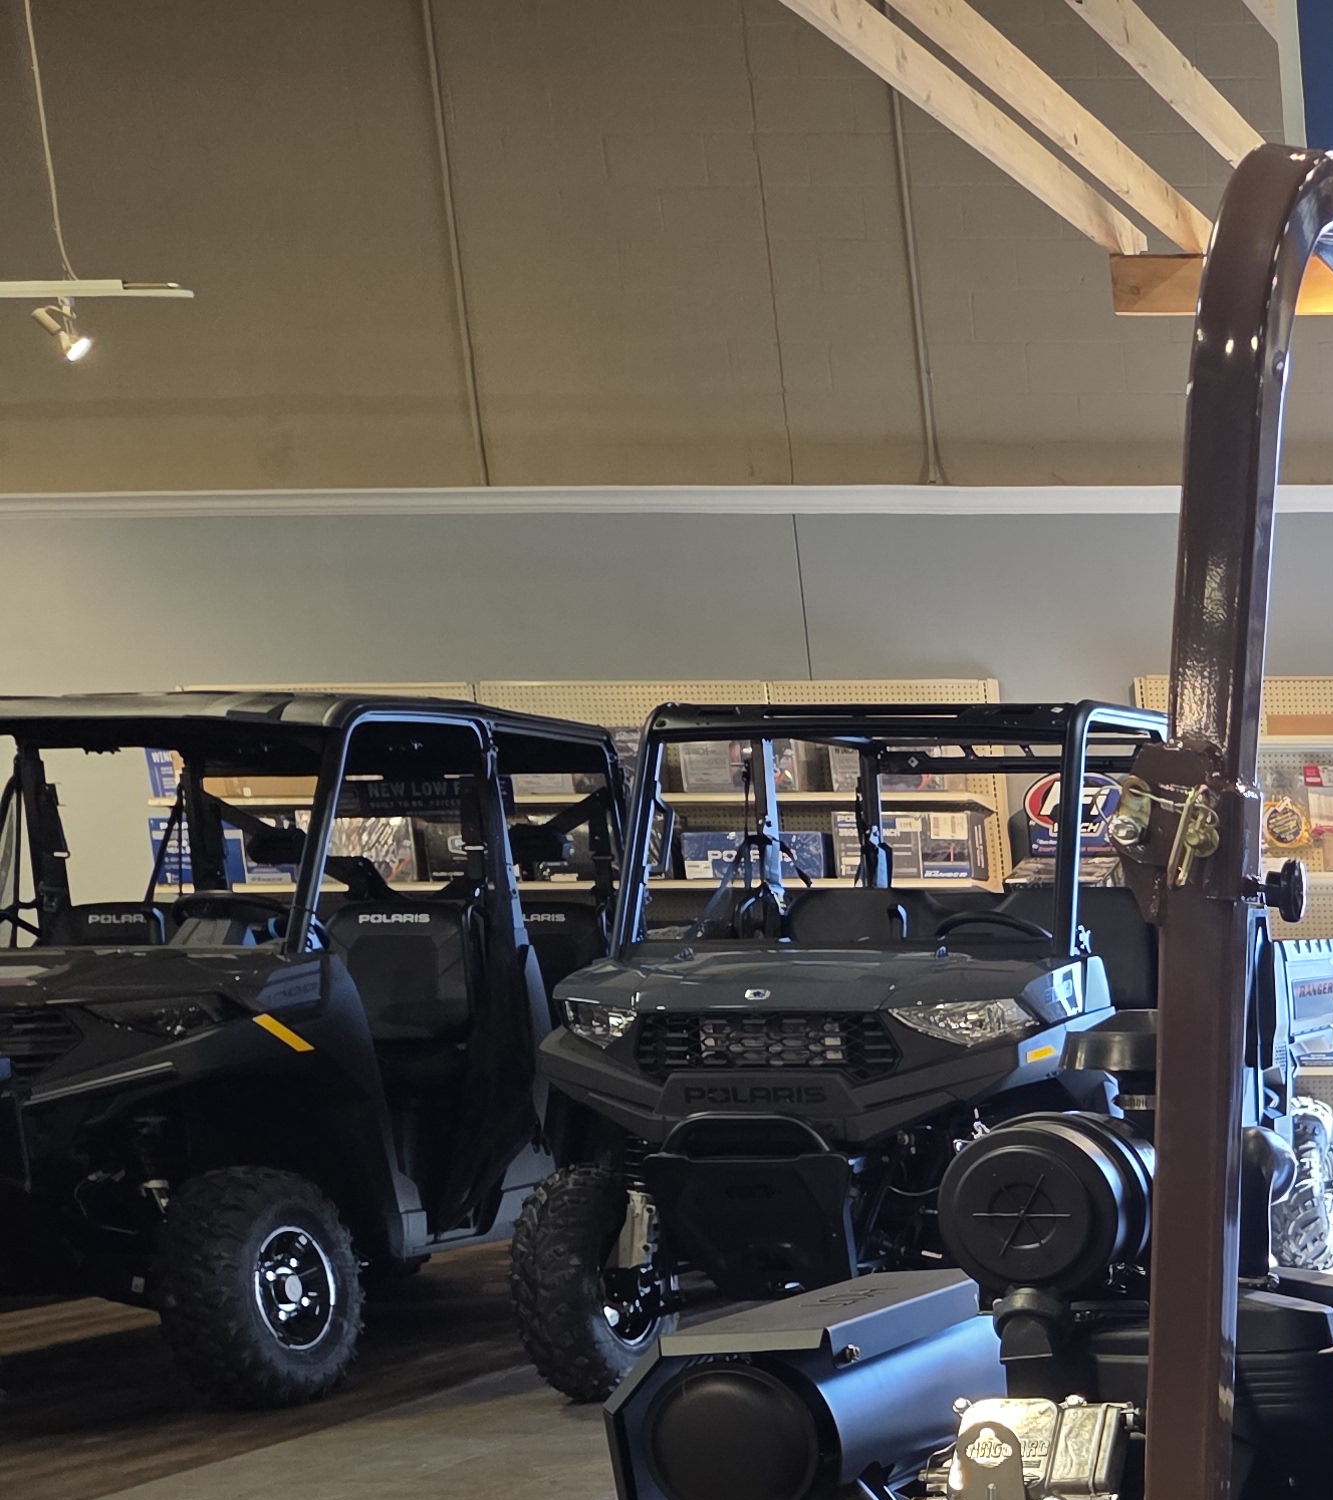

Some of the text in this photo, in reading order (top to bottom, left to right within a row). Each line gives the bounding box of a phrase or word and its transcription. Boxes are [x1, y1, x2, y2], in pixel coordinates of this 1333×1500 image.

[367, 783, 405, 798] NEW
[411, 782, 448, 798] LOW
[358, 914, 431, 924] POLARIS
[1299, 982, 1333, 998] RANGER
[684, 1086, 827, 1104] POLARIS
